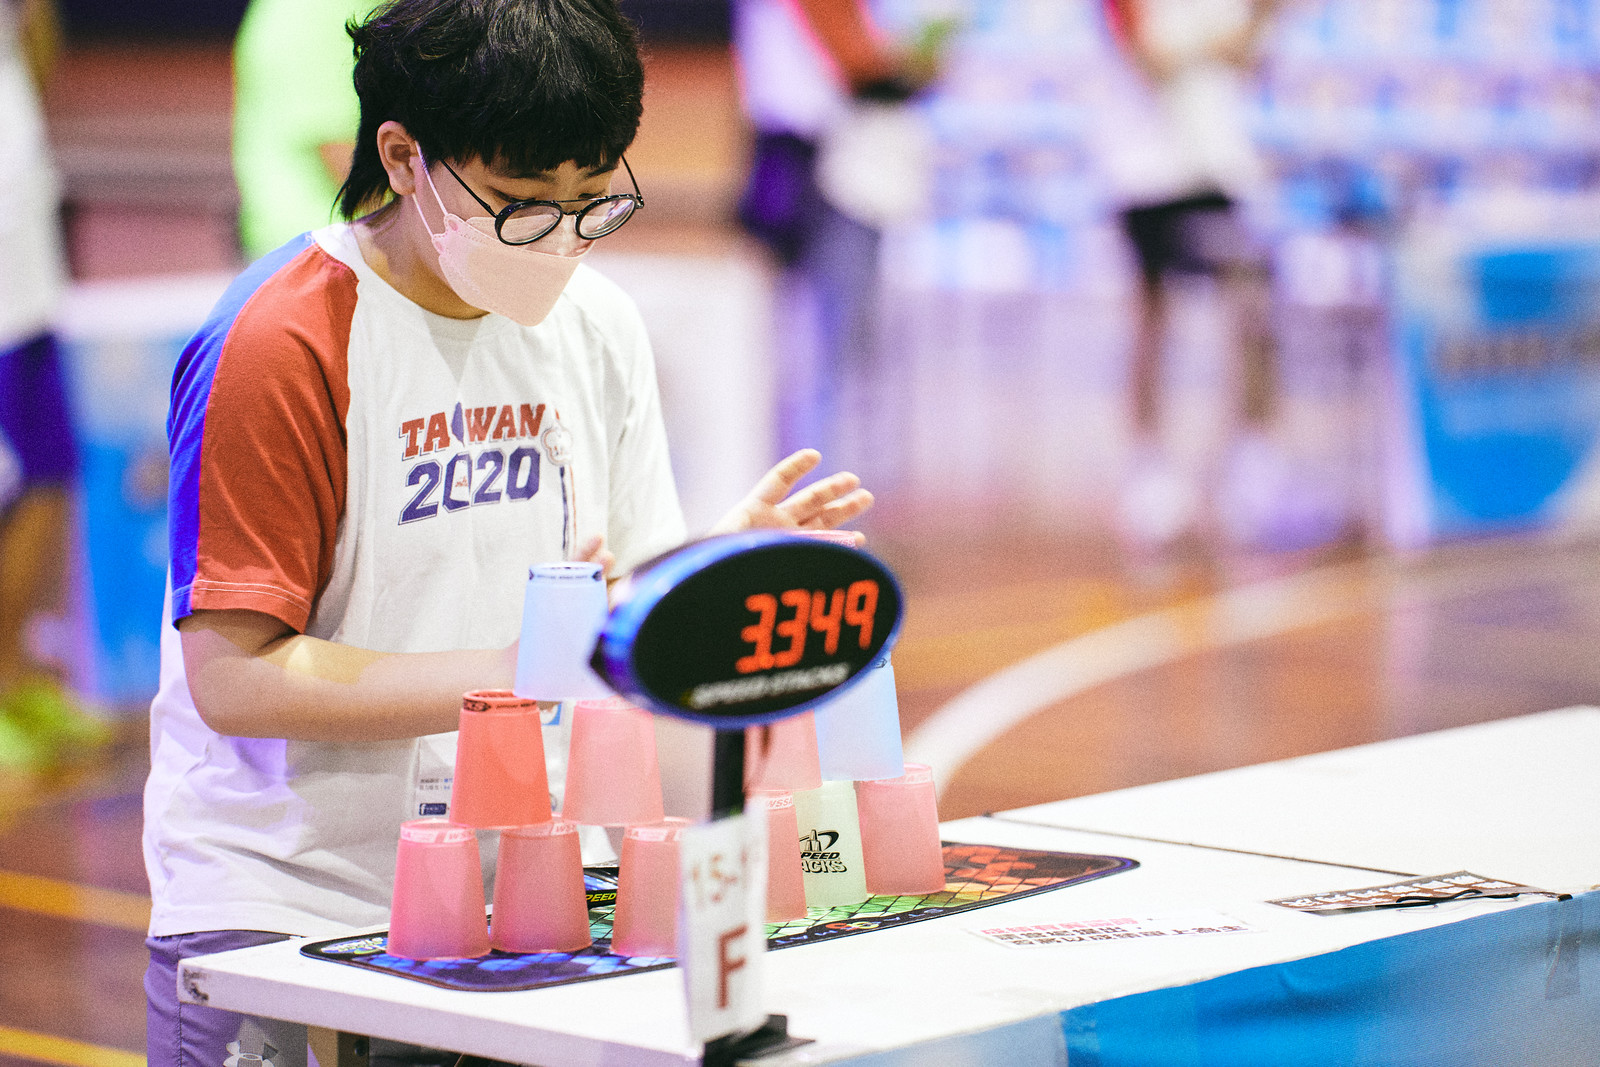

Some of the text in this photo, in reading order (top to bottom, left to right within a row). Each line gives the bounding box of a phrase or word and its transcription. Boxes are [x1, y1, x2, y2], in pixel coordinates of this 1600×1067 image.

[399, 402, 546, 461] TAIWAN
[398, 446, 540, 525] 2020
[800, 851, 840, 860] PEED
[801, 860, 848, 873] ACKS
[585, 893, 617, 902] PEED
[718, 924, 748, 1009] F
